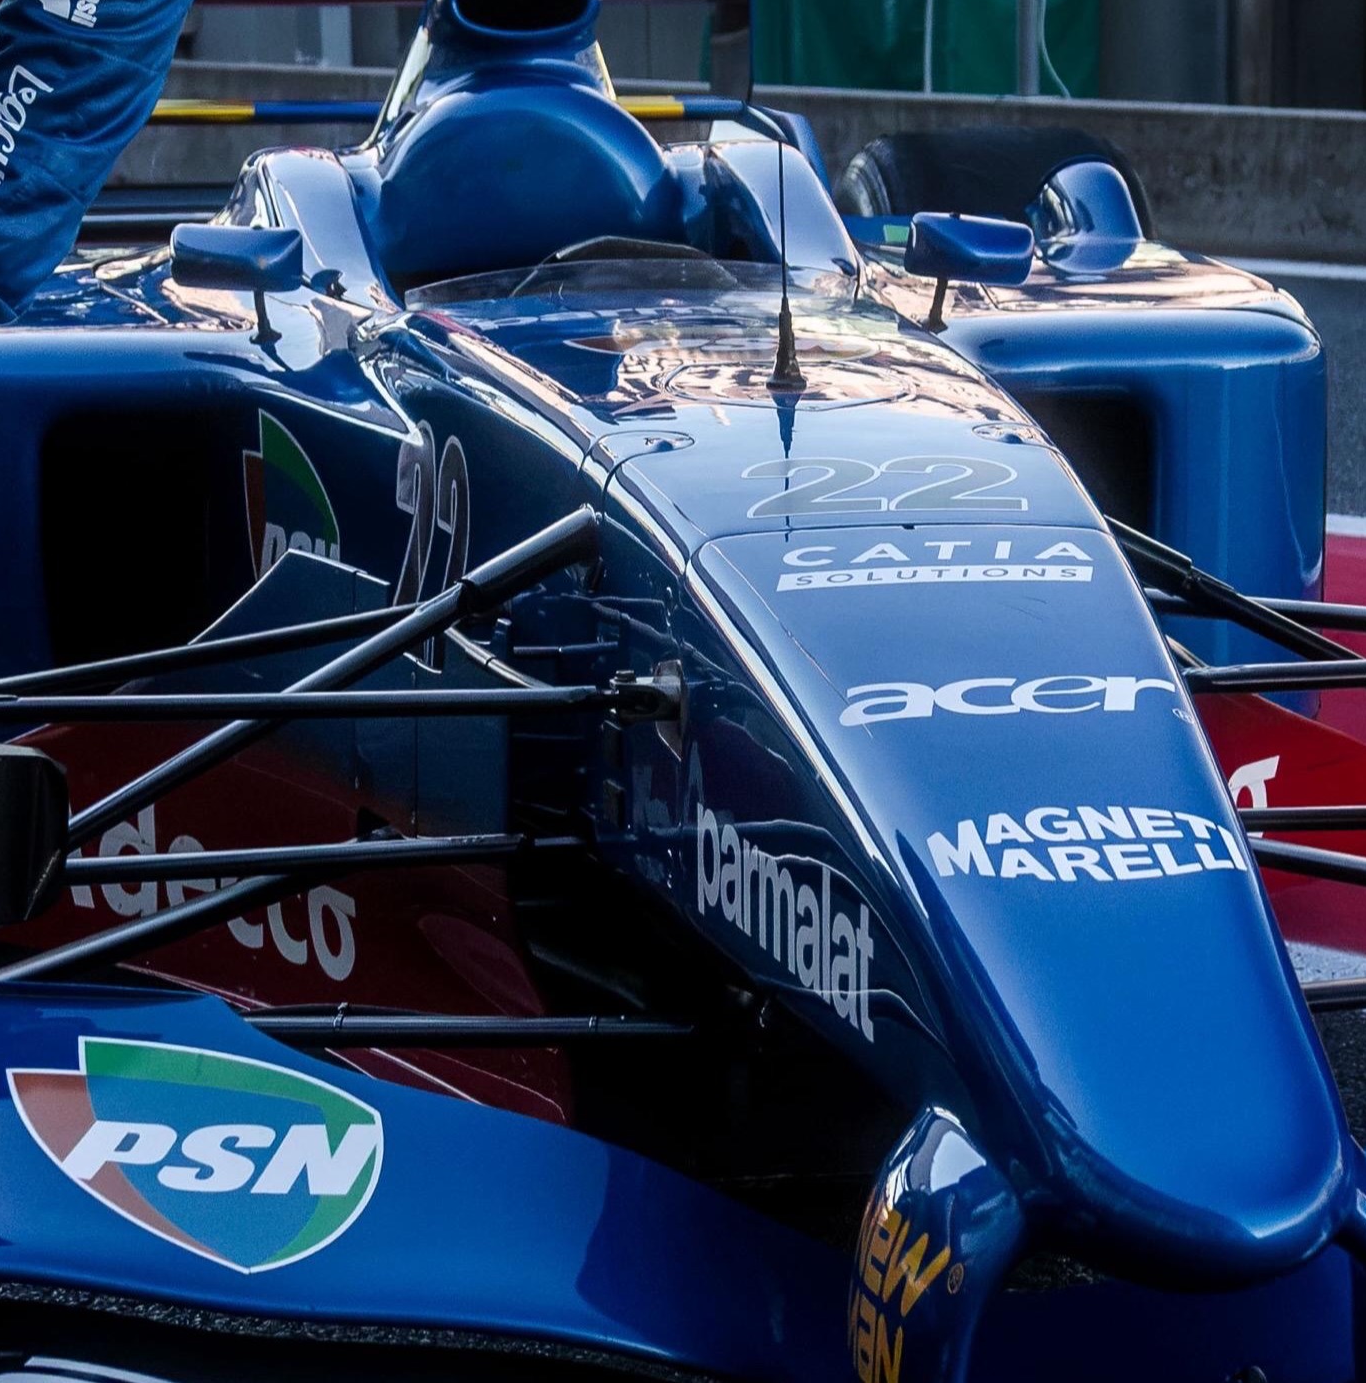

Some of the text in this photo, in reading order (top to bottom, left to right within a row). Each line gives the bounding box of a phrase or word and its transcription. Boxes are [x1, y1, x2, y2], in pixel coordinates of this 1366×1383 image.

[741, 455, 1030, 519] 22
[781, 540, 1094, 568] CATIA
[795, 565, 1080, 588] SOLUTIONS
[839, 674, 1176, 728] acer
[697, 802, 875, 1044] parmalat
[62, 1119, 377, 1196] PSN
